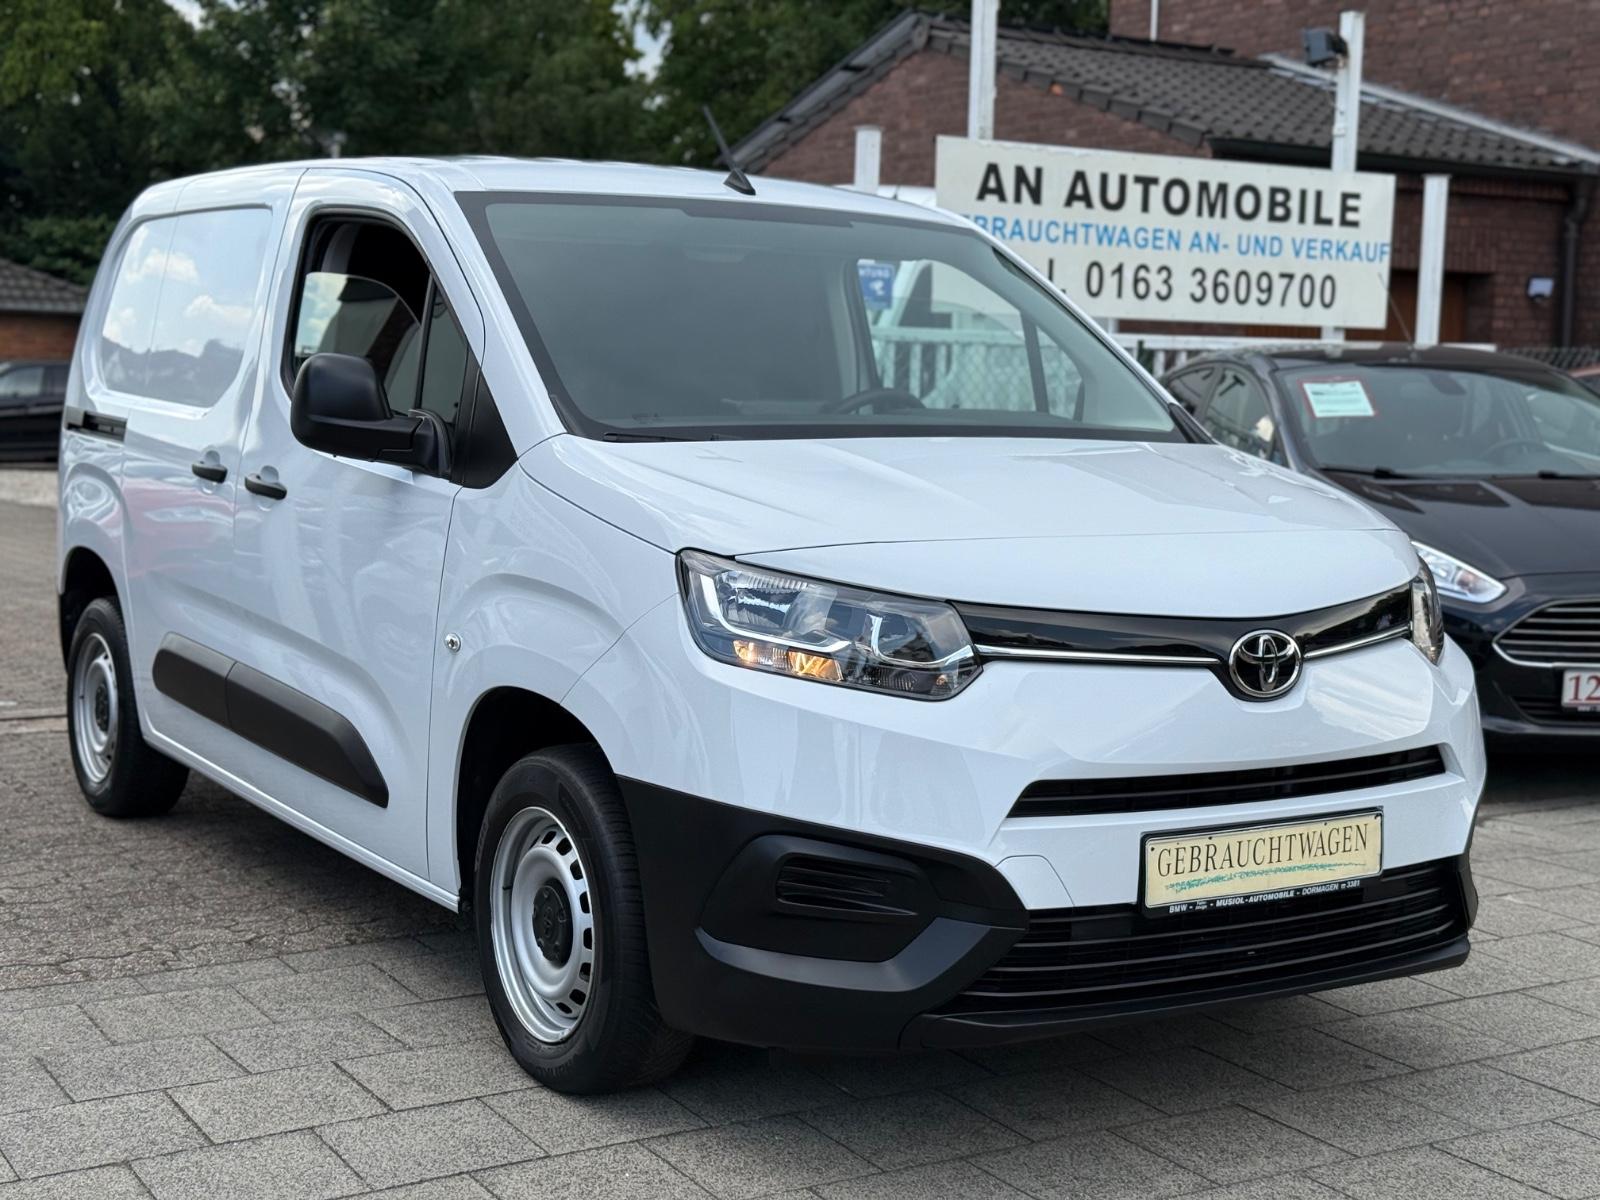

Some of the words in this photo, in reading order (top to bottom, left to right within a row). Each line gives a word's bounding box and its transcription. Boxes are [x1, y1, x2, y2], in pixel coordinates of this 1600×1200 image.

[976, 162, 1044, 206] AN
[1064, 170, 1362, 228] AUTOMOBILE
[963, 214, 1182, 252] BRAUCHTWAGEN
[1188, 231, 1230, 254] AN-
[1237, 234, 1284, 258] UND
[1291, 237, 1392, 264] VERKAUF
[1085, 260, 1173, 302] 0163
[1189, 267, 1337, 310] 3609700
[1157, 823, 1369, 878] GEBRAUCHTWAGEN
[1169, 903, 1188, 913] BMW
[1301, 882, 1339, 896] DORMAGEN
